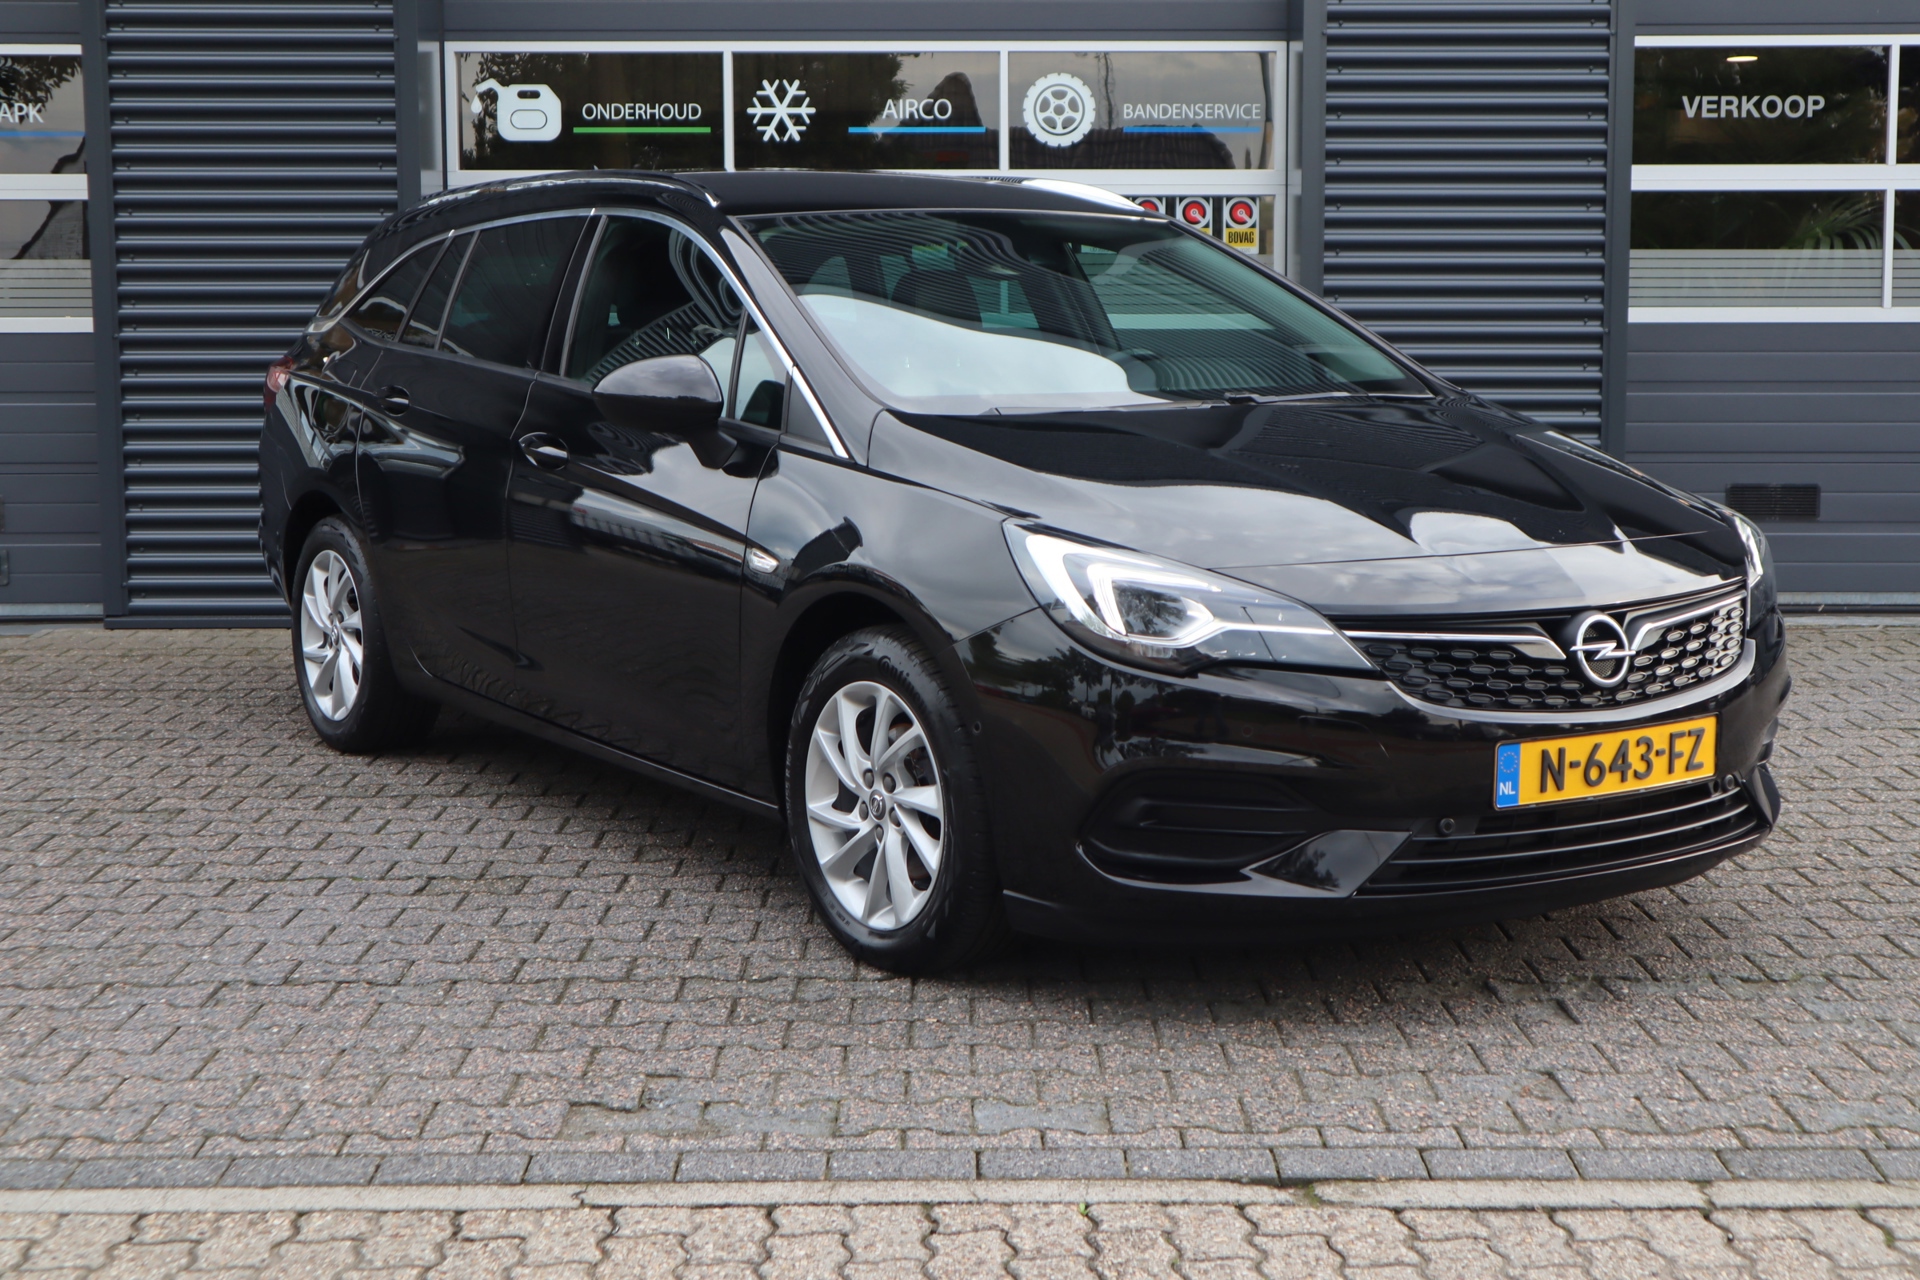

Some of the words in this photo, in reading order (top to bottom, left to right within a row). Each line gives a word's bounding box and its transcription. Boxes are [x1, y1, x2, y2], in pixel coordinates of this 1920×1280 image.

[0, 102, 44, 123] APK
[582, 102, 702, 120] ONDERHOUD
[882, 98, 952, 120] AIRCO
[1123, 103, 1261, 119] BANDENSERVICE
[1682, 94, 1826, 118] VERKOOP
[1228, 231, 1255, 244] BOVAG
[1539, 727, 1706, 794] N-643-FZ
[1499, 782, 1516, 796] NL
